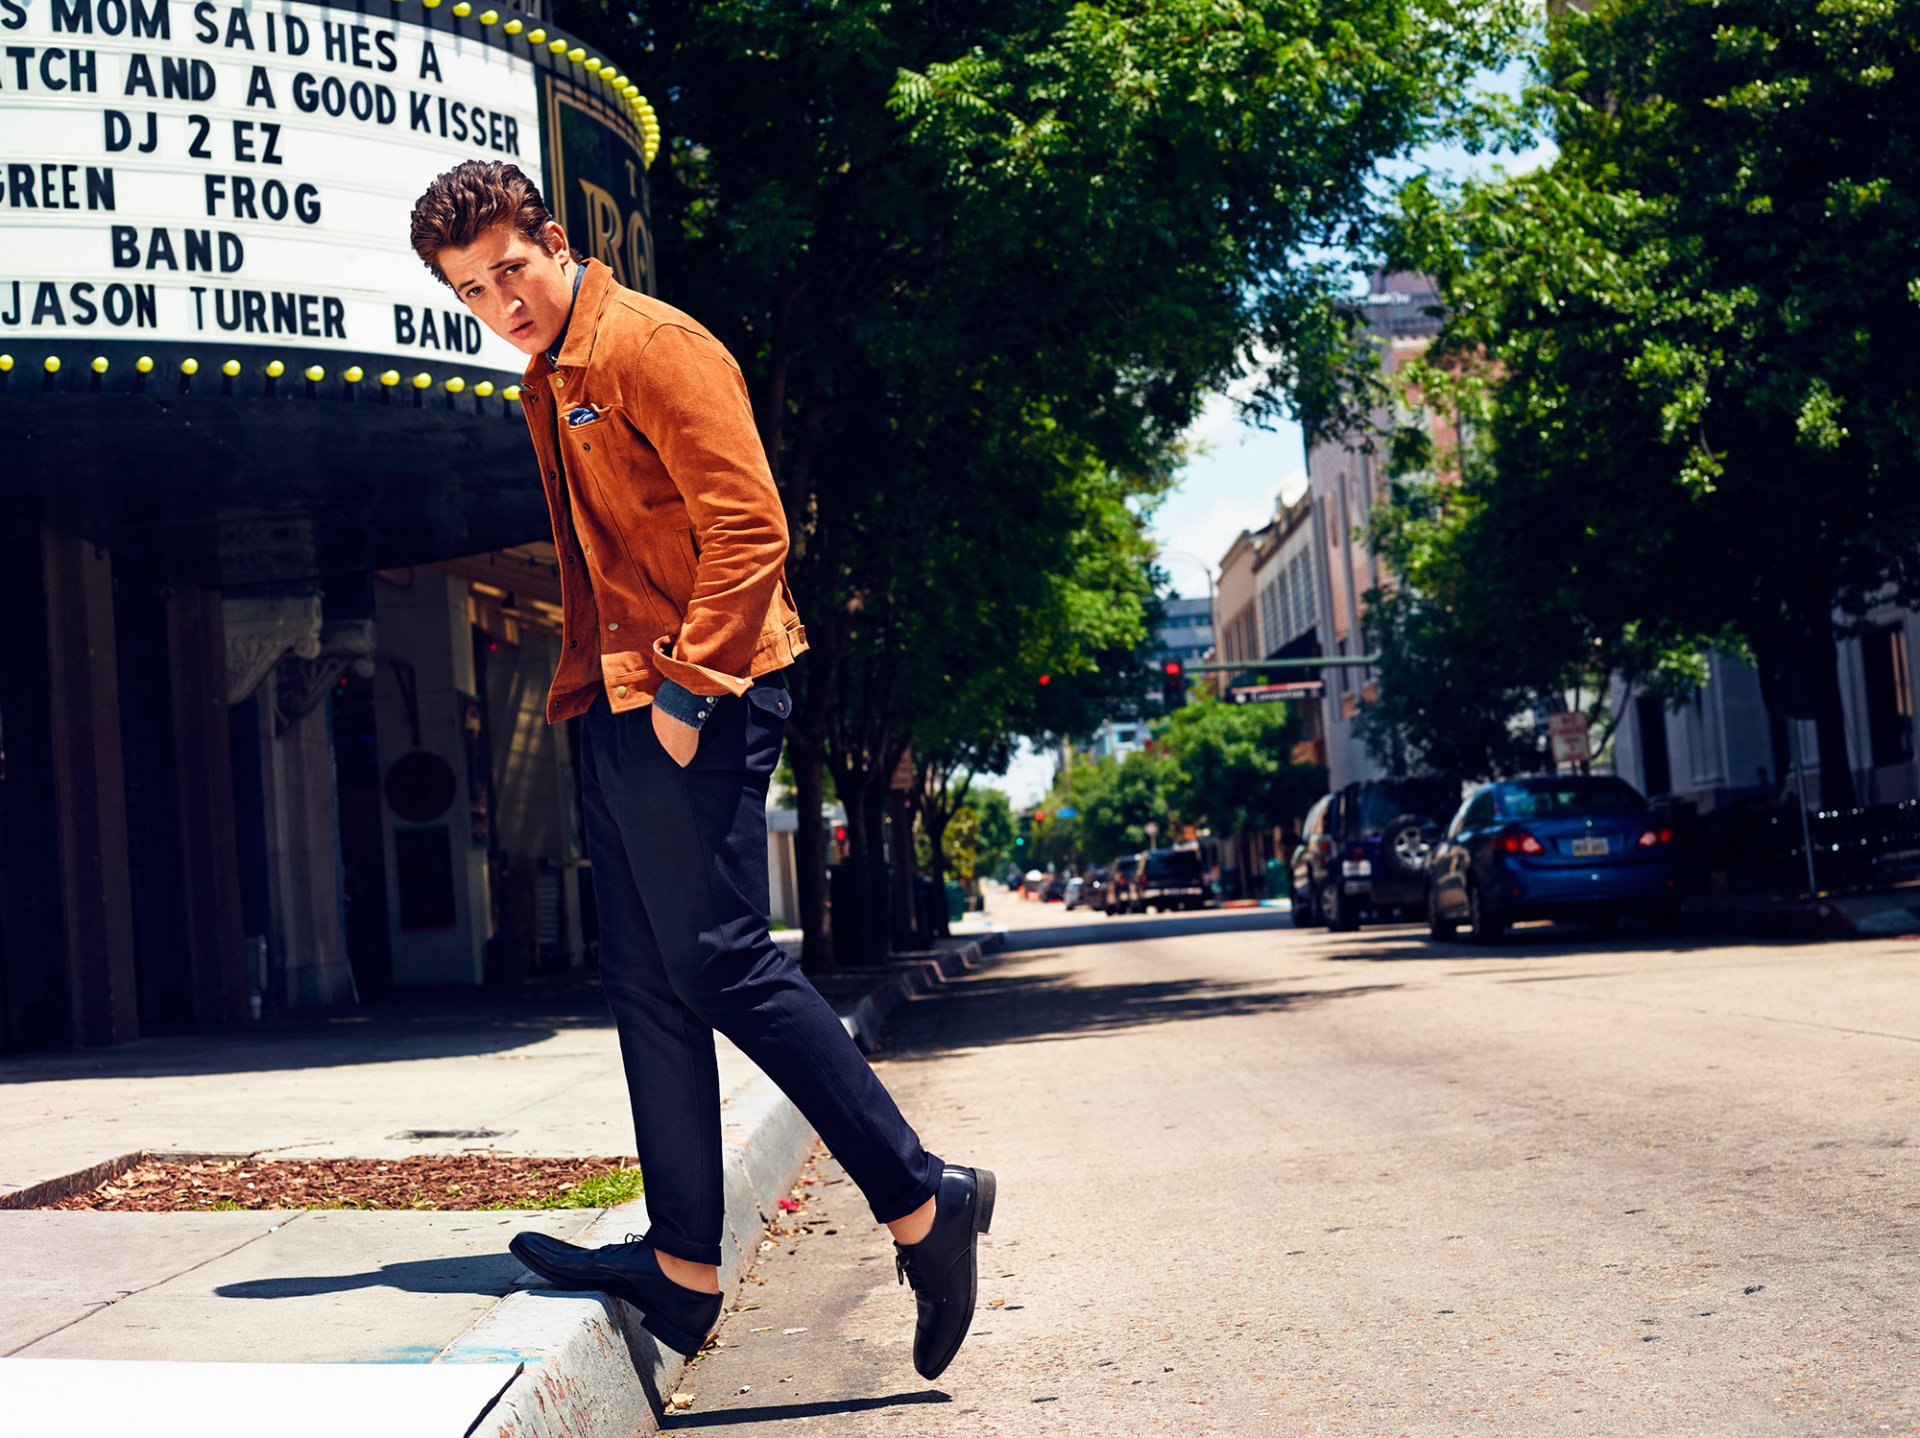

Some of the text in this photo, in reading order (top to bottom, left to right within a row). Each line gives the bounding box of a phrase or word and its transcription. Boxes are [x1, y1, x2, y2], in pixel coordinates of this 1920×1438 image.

[51, 0, 170, 41] MOM
[194, 2, 310, 56] SAID
[323, 21, 398, 73] HES
[419, 41, 443, 83] A
[0, 46, 520, 156] TCH AND A GOOD KISSER
[103, 109, 283, 165] DJ 2 EZ
[0, 163, 321, 225] REEN FROG
[111, 225, 244, 273] BAND
[2, 280, 482, 355] JASON TURNER BAND
